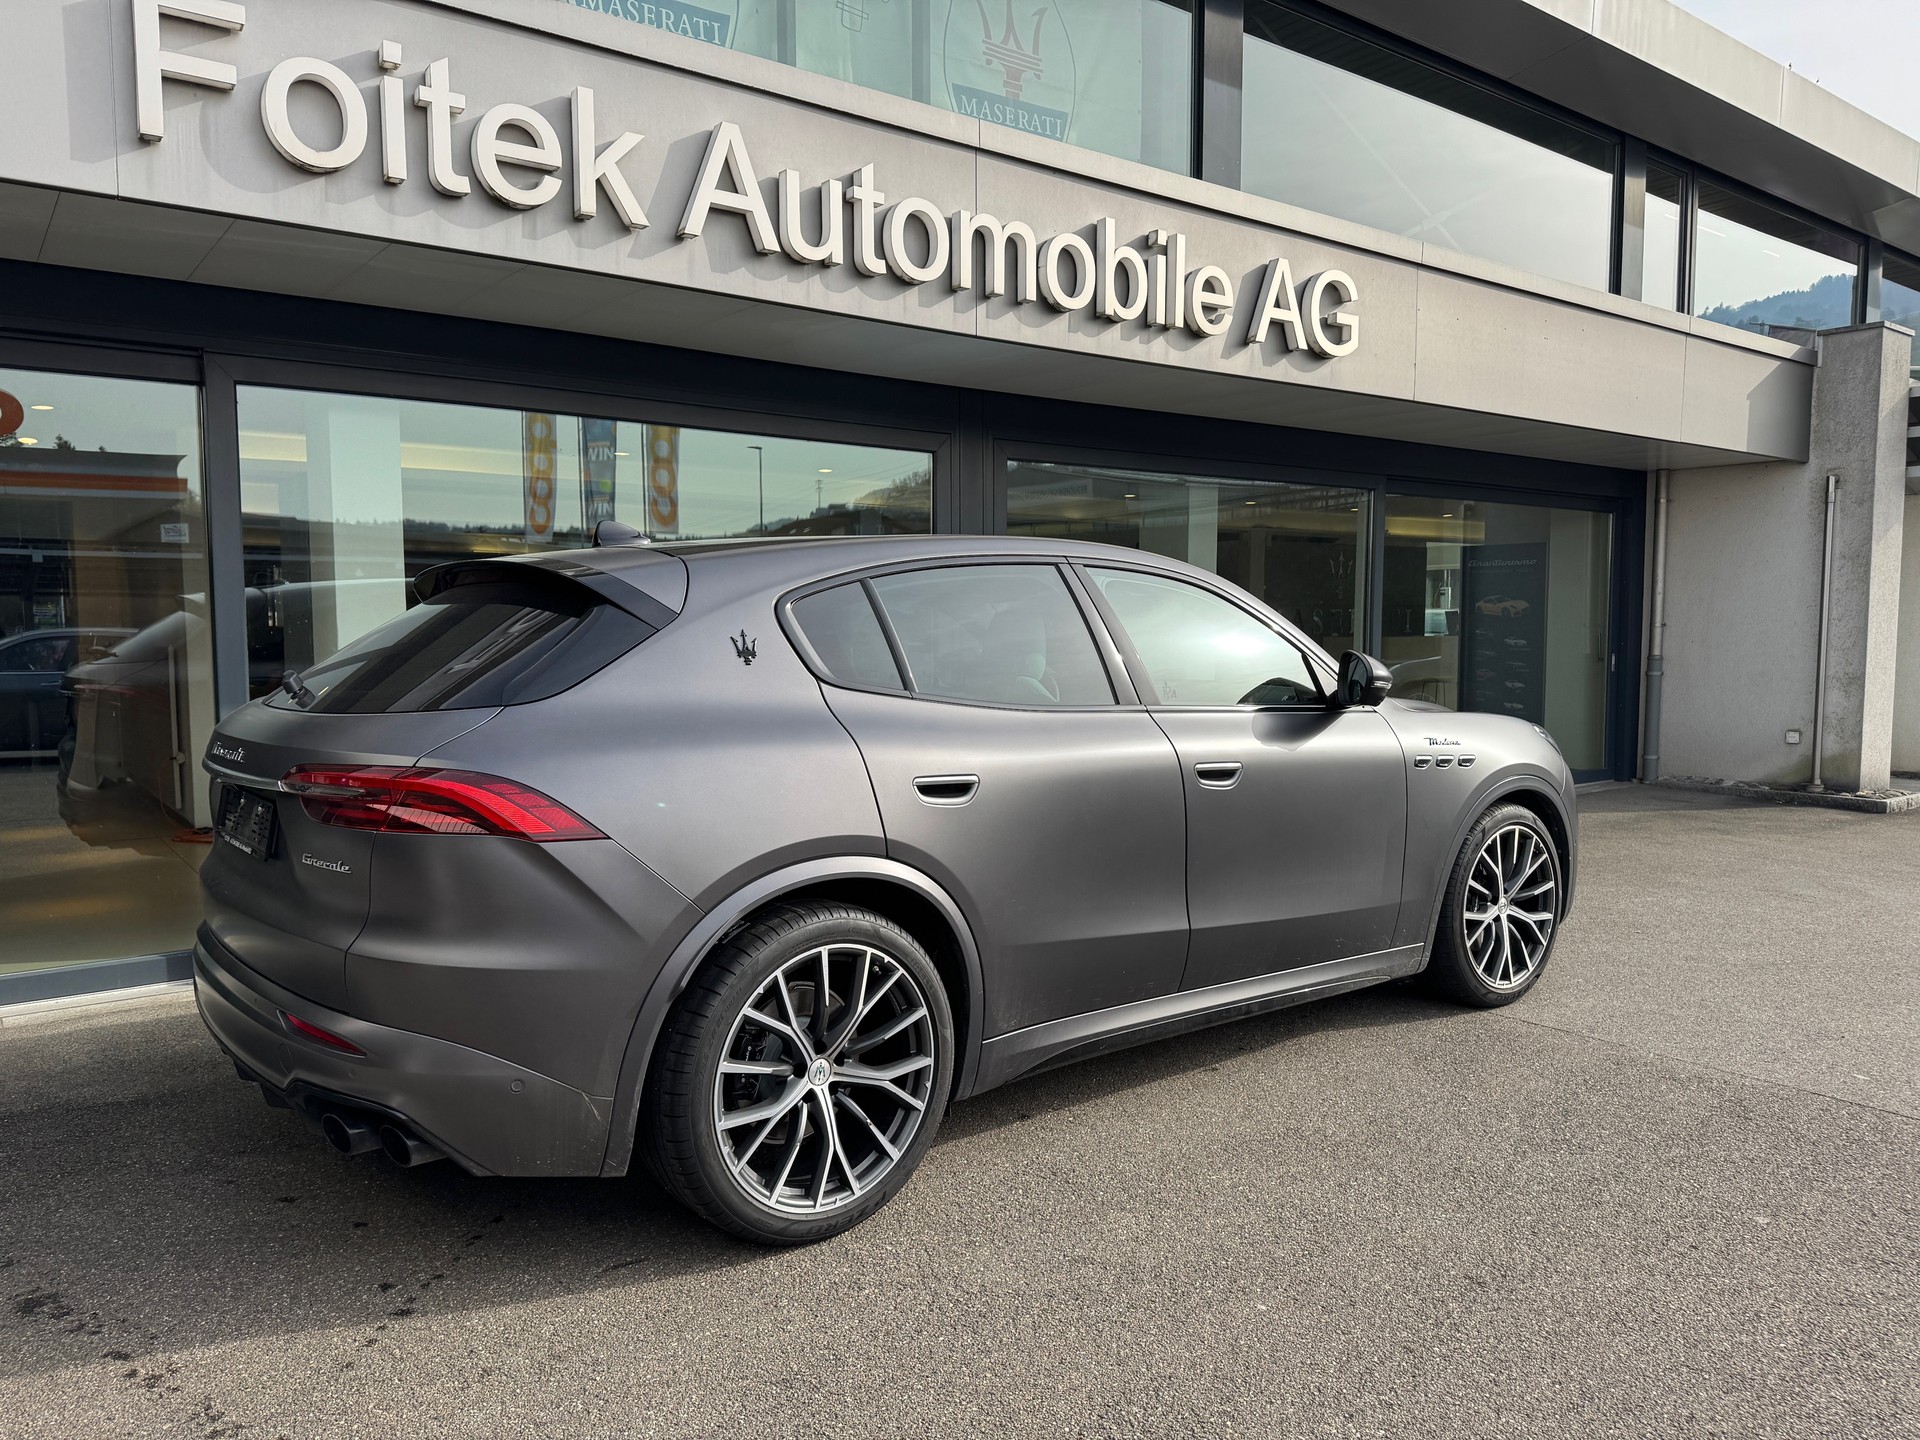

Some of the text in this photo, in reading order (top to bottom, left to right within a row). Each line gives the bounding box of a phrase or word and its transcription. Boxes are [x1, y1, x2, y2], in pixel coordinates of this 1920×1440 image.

[960, 94, 1062, 138] MASERATI
[133, 0, 1360, 360] Foitek Automobile AG
[587, 446, 616, 462] WIN
[650, 424, 681, 528] coo
[302, 853, 352, 874] Grecale
